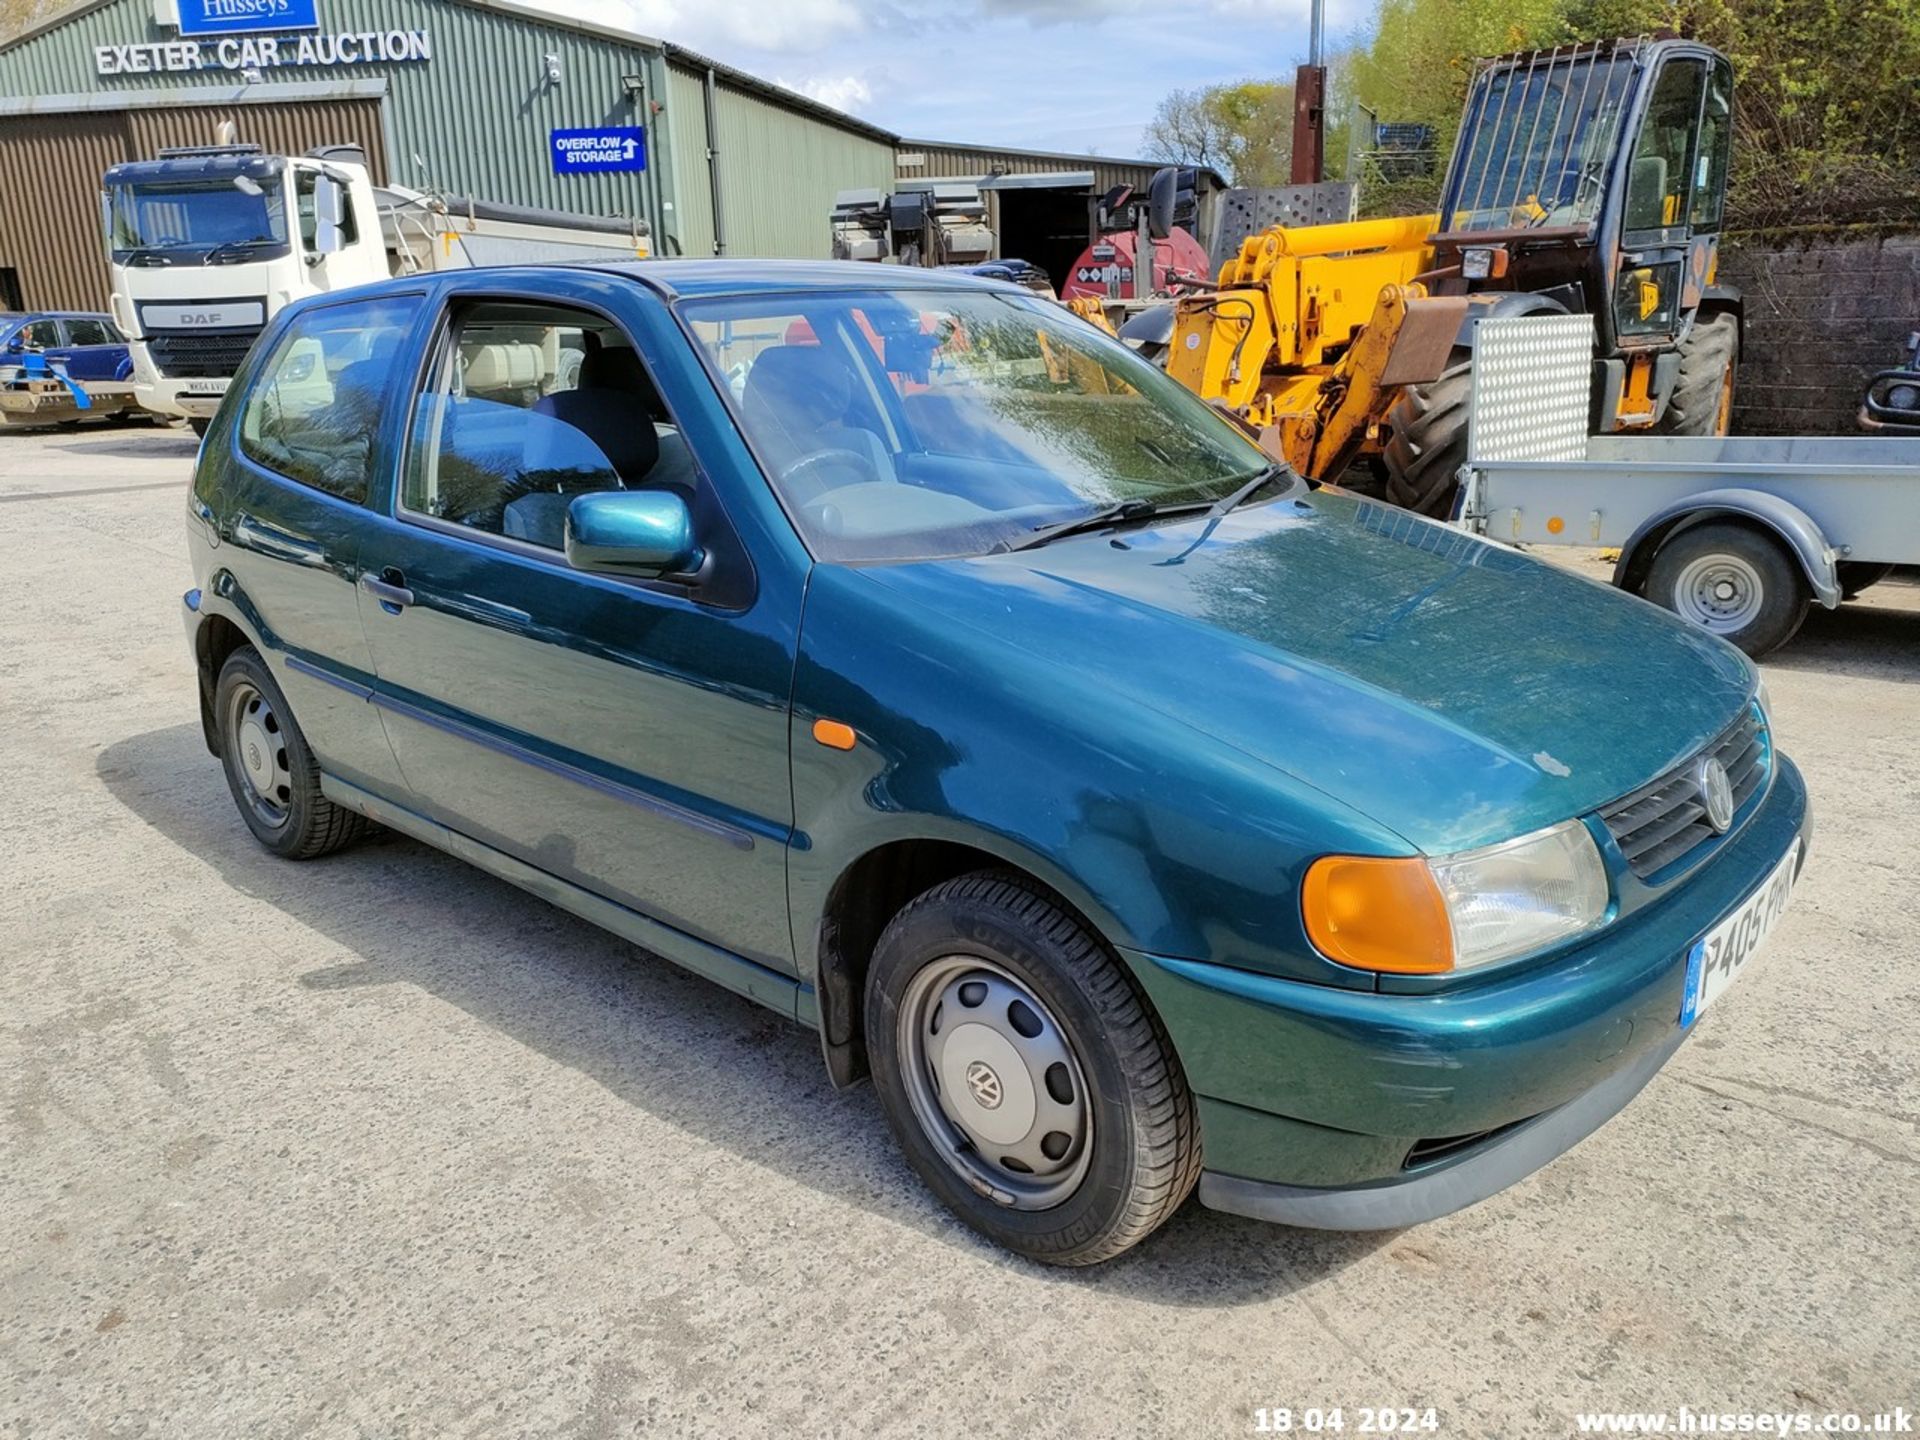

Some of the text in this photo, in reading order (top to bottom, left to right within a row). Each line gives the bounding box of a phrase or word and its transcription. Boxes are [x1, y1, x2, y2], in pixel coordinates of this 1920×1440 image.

[203, 0, 288, 16] Husseys
[95, 29, 431, 74] EXETER CAR AUCTION
[556, 136, 621, 151] OVERFLOW
[566, 150, 622, 163] STORAGE
[180, 313, 222, 324] DAF
[1701, 892, 1765, 1001] P405
